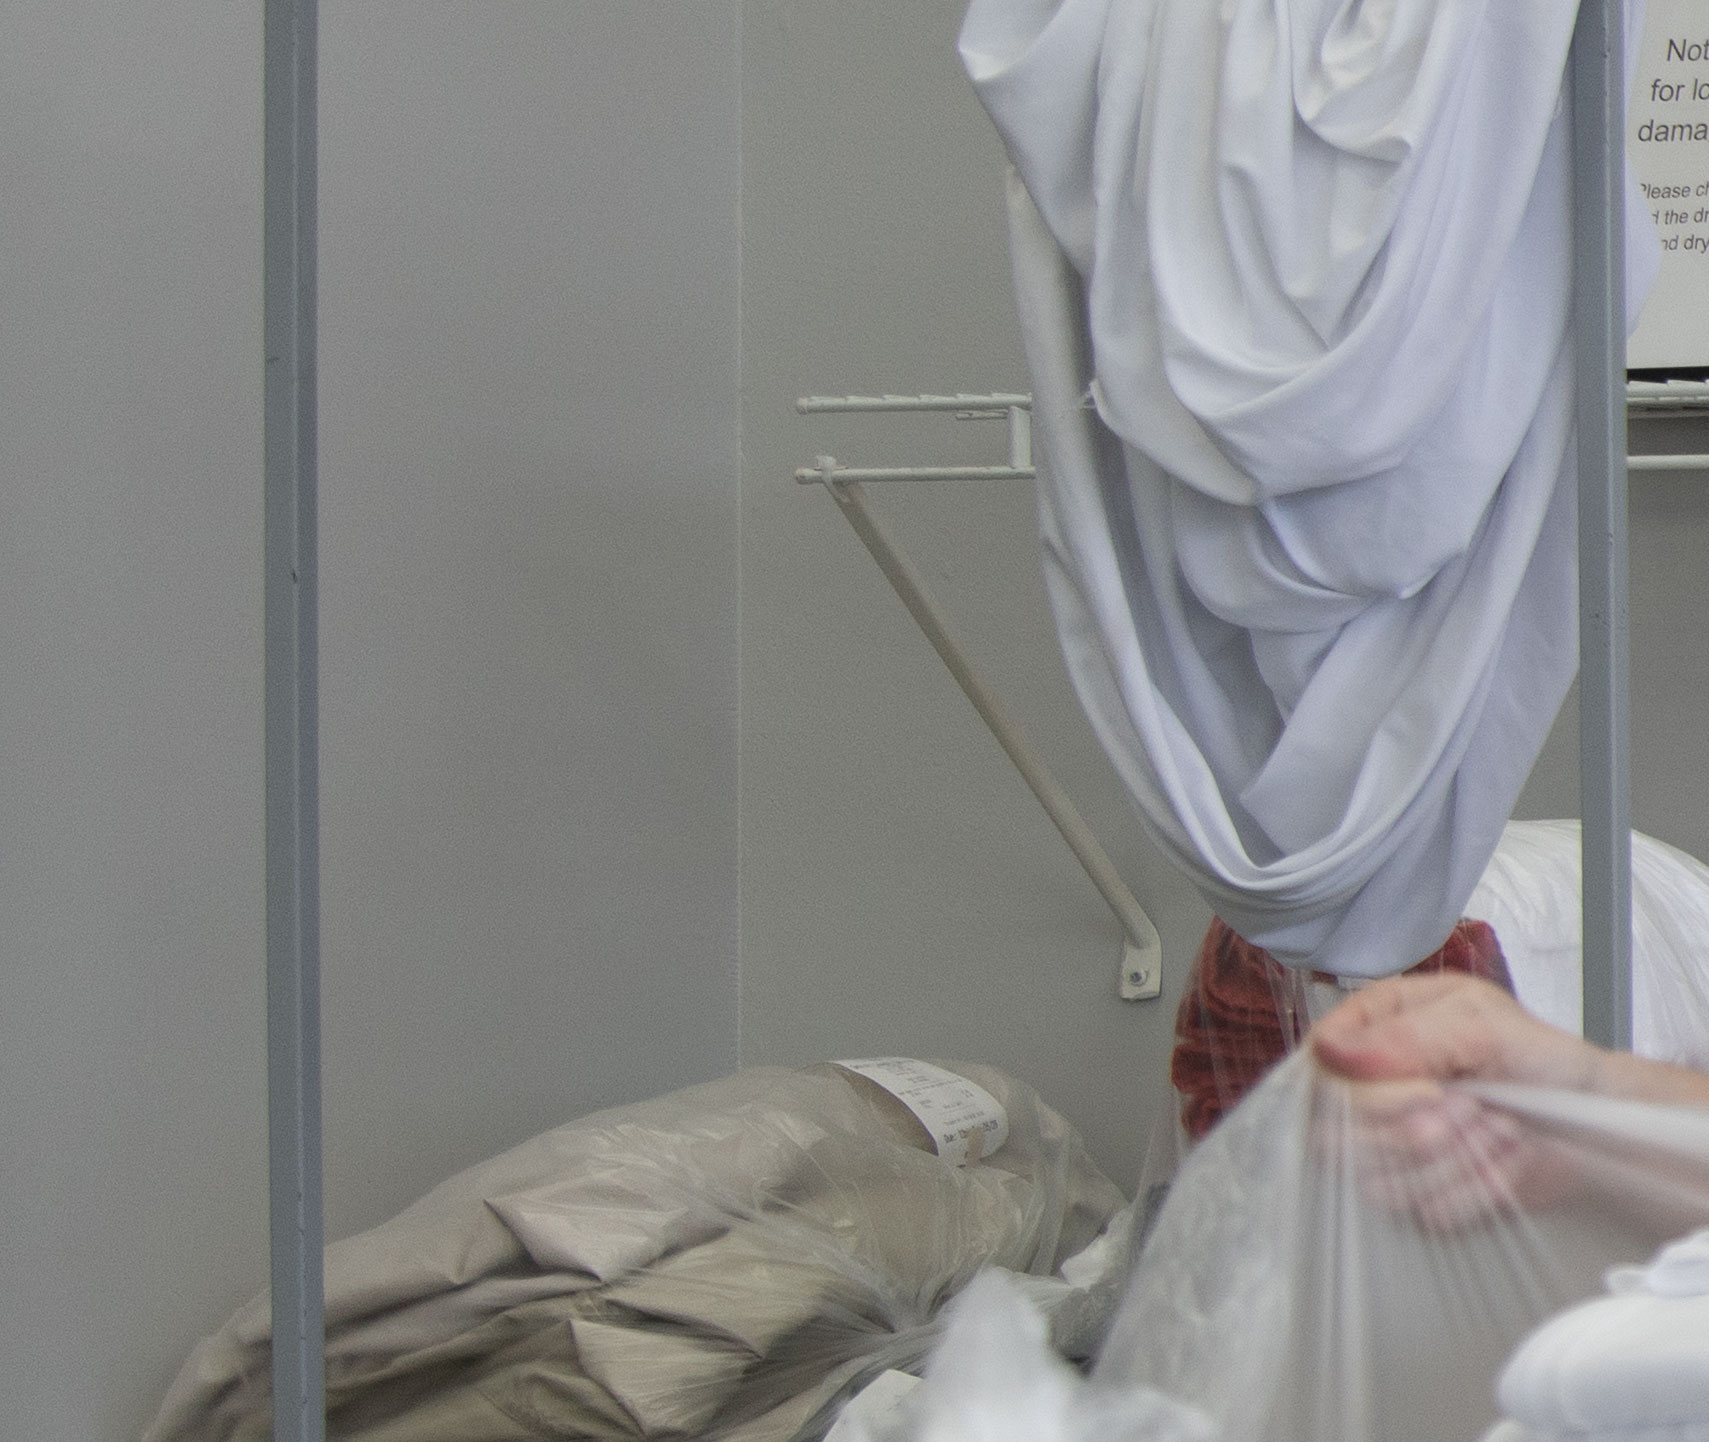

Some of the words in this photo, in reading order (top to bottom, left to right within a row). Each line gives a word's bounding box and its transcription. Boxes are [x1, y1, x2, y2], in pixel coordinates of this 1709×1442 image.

[1650, 78, 1686, 102] for
[1664, 210, 1688, 225] the
[1661, 236, 1679, 250] nd
